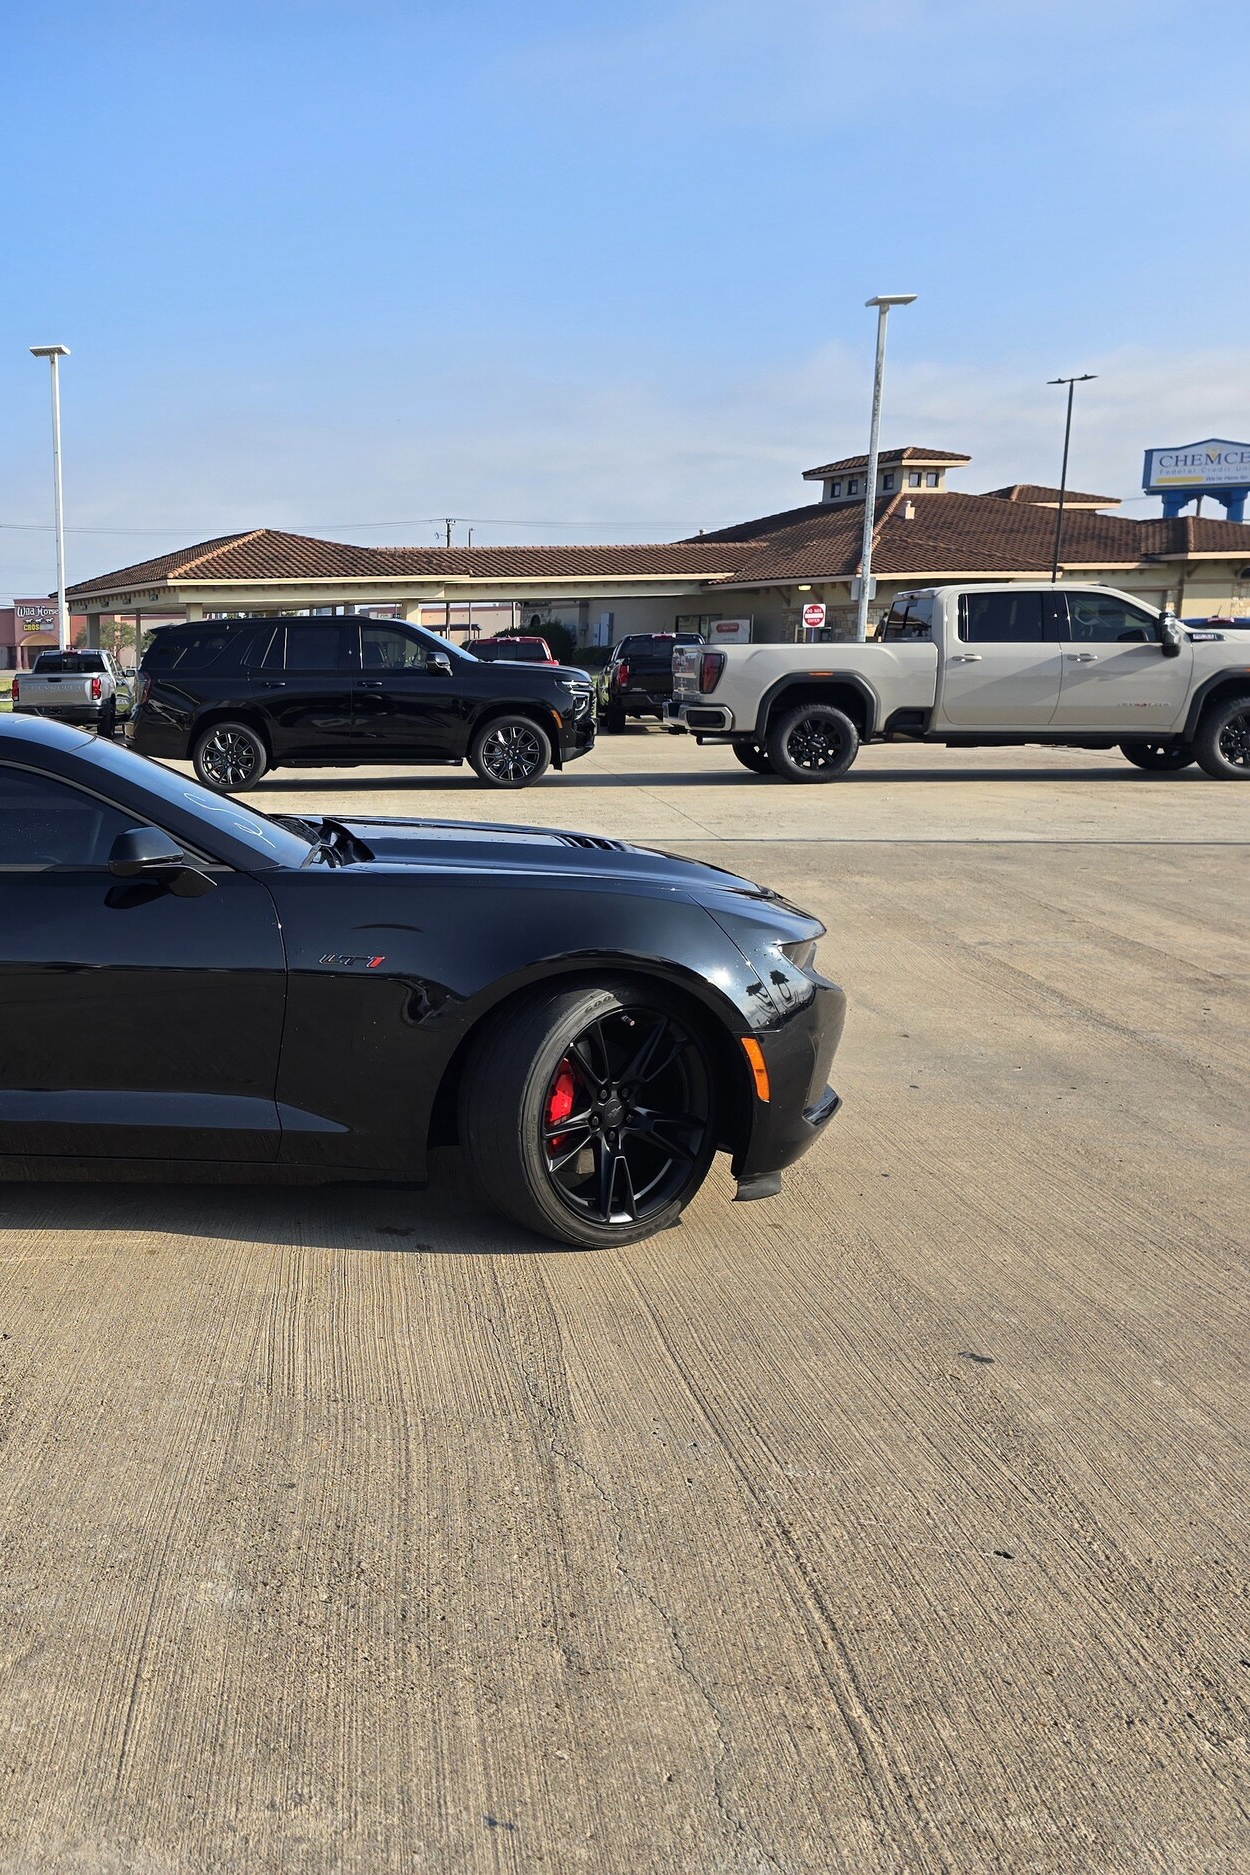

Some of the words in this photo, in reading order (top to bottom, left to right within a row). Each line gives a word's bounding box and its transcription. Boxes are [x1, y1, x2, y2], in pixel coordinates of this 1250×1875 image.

[1159, 467, 1196, 475] Federal
[17, 606, 35, 617] Wild
[35, 605, 60, 616] Horse
